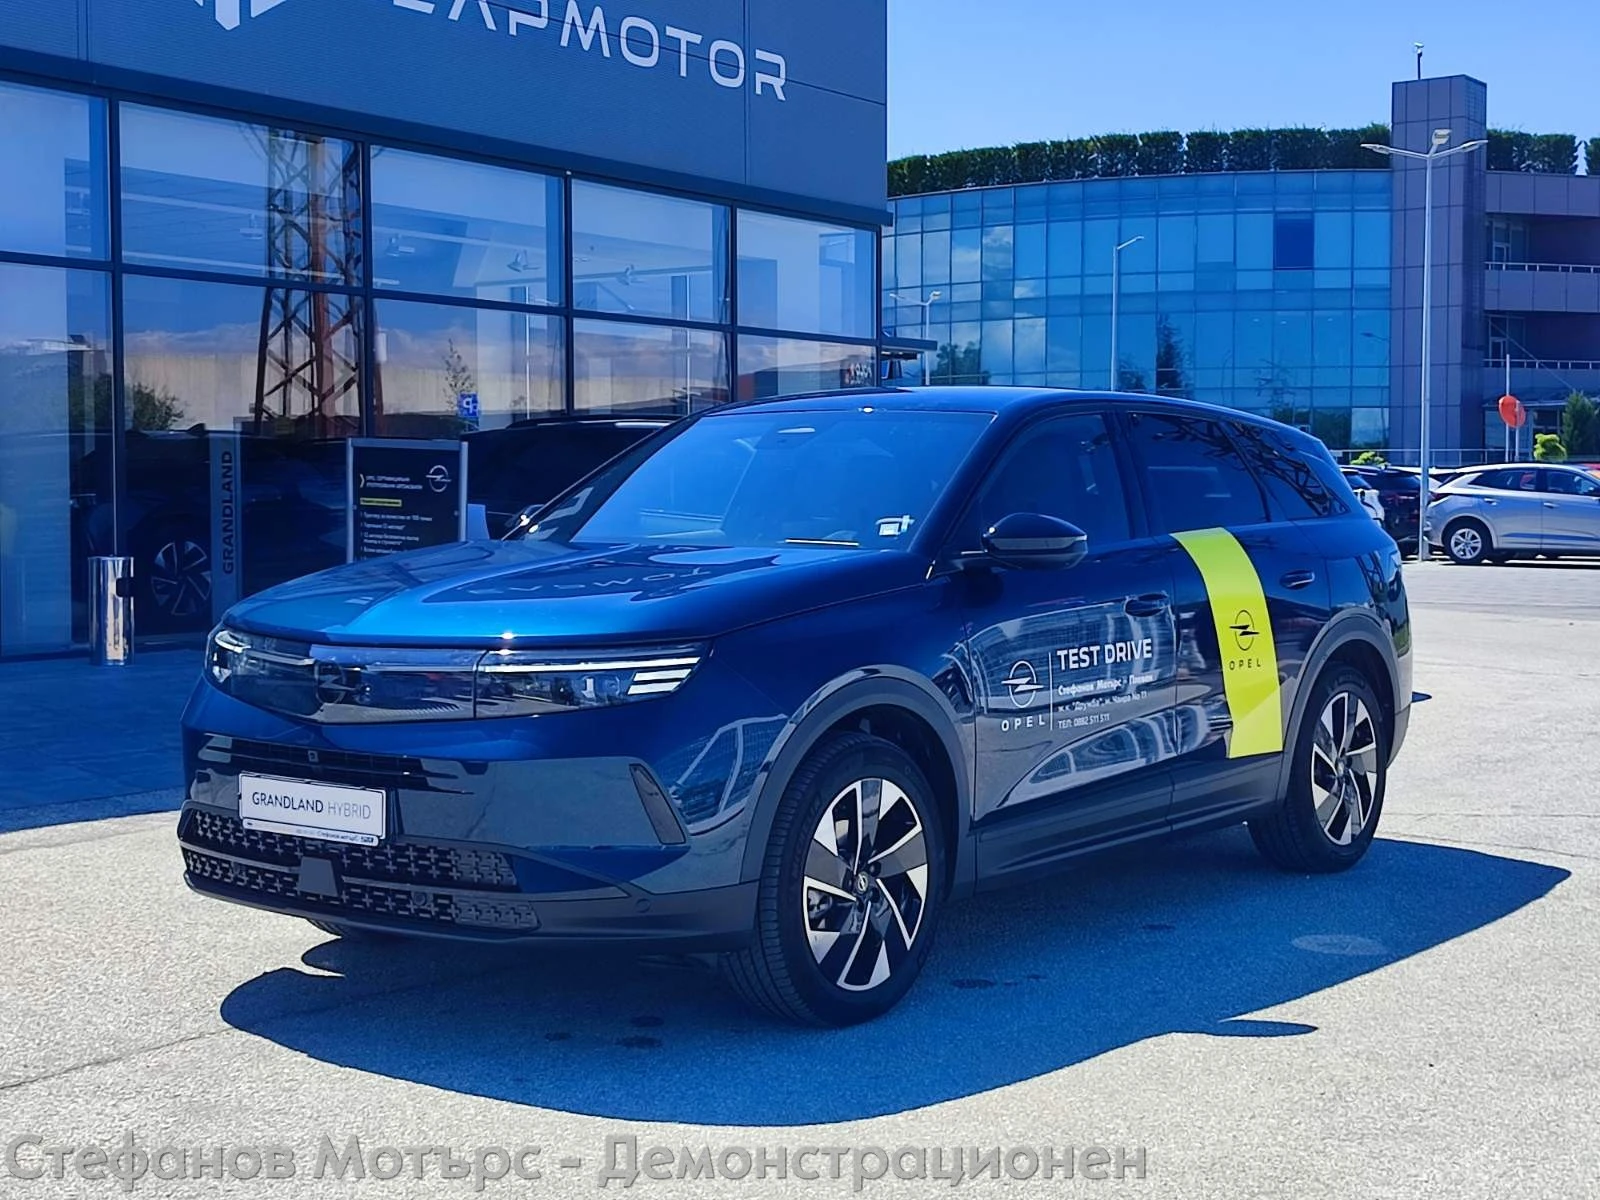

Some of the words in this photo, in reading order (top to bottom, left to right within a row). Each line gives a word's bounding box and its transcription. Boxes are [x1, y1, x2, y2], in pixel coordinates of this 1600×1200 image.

[221, 450, 234, 575] GRANDLAND
[1056, 645, 1101, 671] TEST
[1104, 638, 1152, 665] DRIVE
[1229, 658, 1261, 671] OPEL
[1001, 714, 1046, 732] OPEL
[251, 791, 324, 813] GRANDLAND
[327, 801, 372, 820] HYBRID
